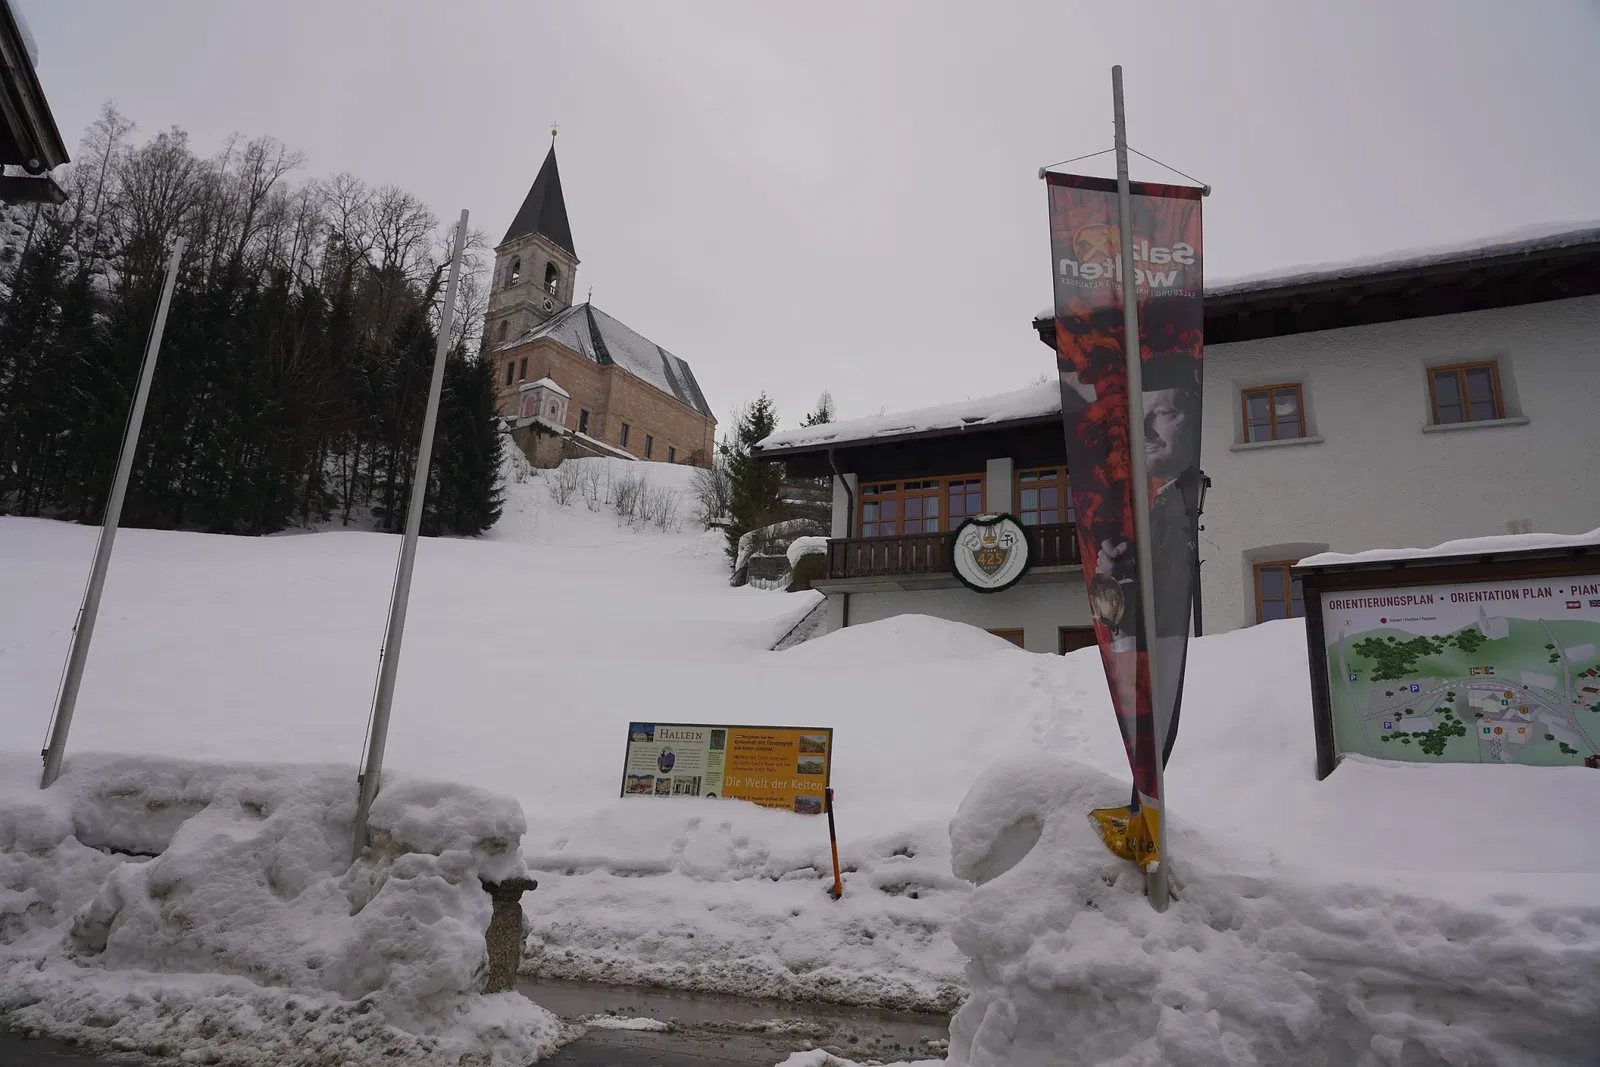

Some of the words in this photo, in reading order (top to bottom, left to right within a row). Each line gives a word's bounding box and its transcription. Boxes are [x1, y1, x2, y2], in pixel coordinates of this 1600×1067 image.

[977, 552, 1003, 566] 425
[1329, 594, 1434, 610] ORIENTIERUNGSPLAN
[1450, 588, 1520, 603] ORIENTATION
[1523, 586, 1552, 599] PLAN
[659, 728, 703, 740] HALLEIN
[725, 776, 741, 787] Die
[745, 777, 768, 789] Welt
[771, 778, 787, 789] der
[791, 779, 823, 791] Kelten
